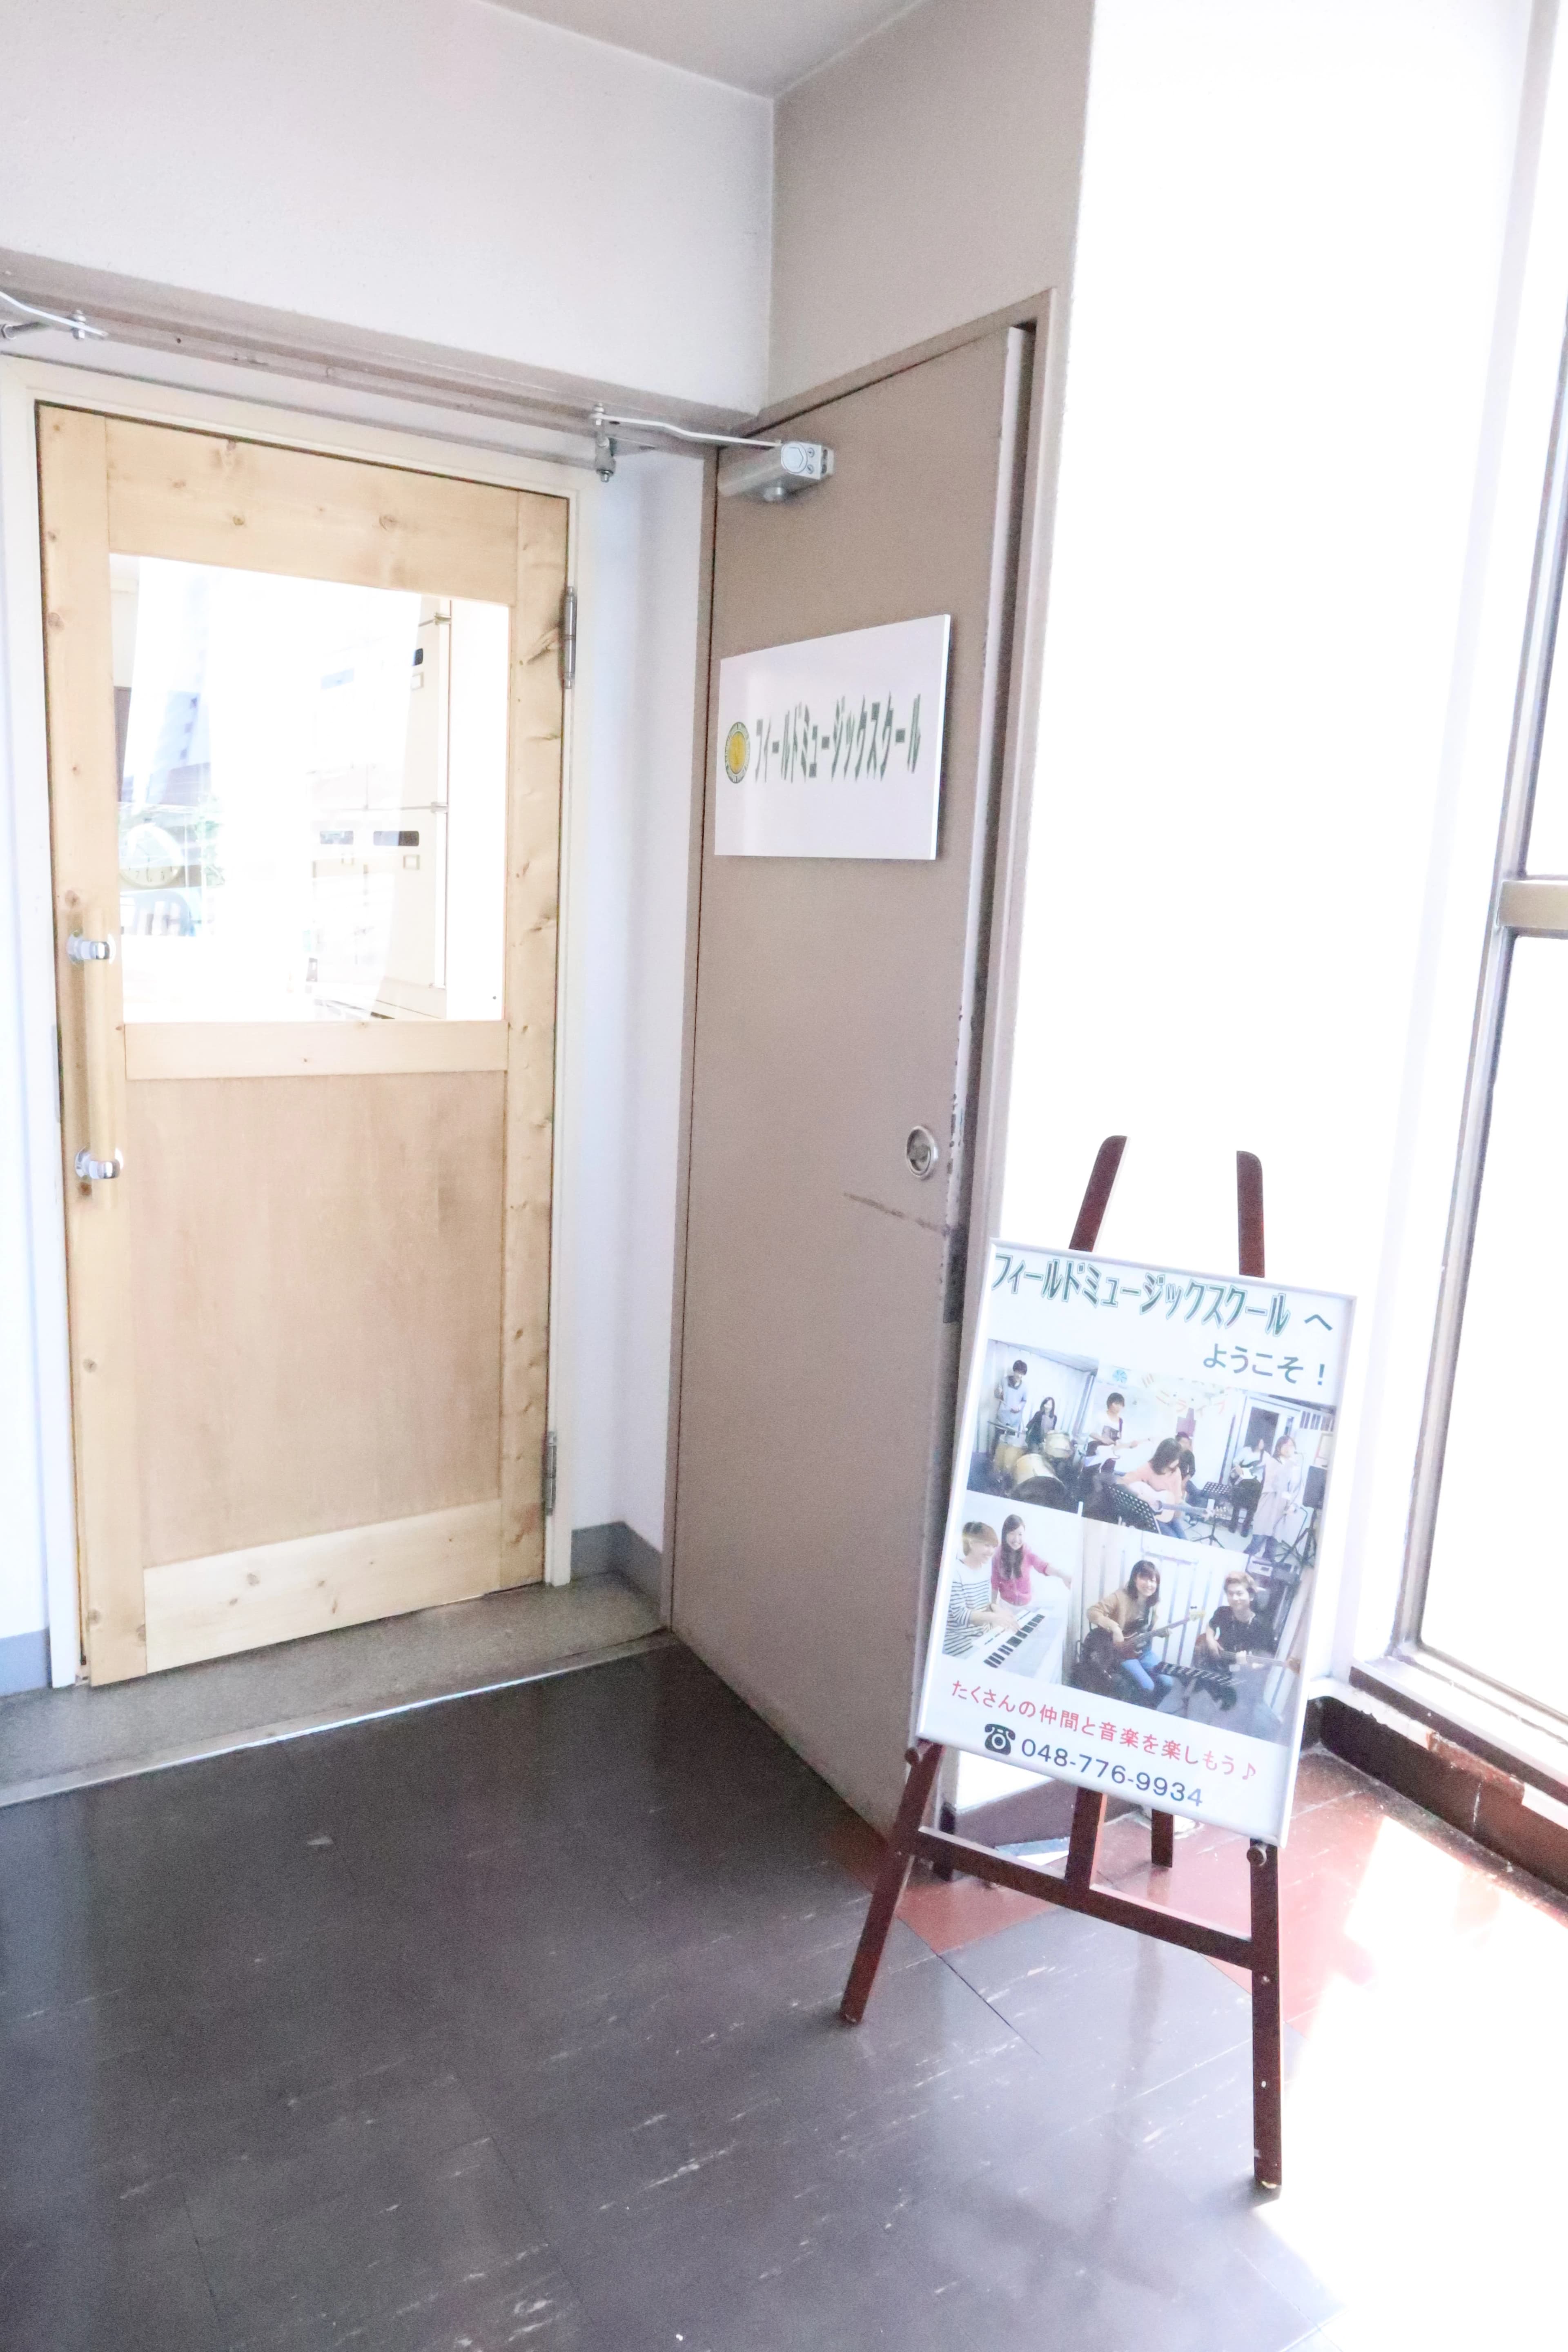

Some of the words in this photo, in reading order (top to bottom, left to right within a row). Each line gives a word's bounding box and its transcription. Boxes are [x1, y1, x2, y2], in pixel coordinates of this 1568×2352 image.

[755, 691, 922, 783] フィールドミュージックスクール
[991, 1253, 1291, 1337] フィールドミュージックスクール
[1021, 1739, 1203, 1806] 048-776-9934
